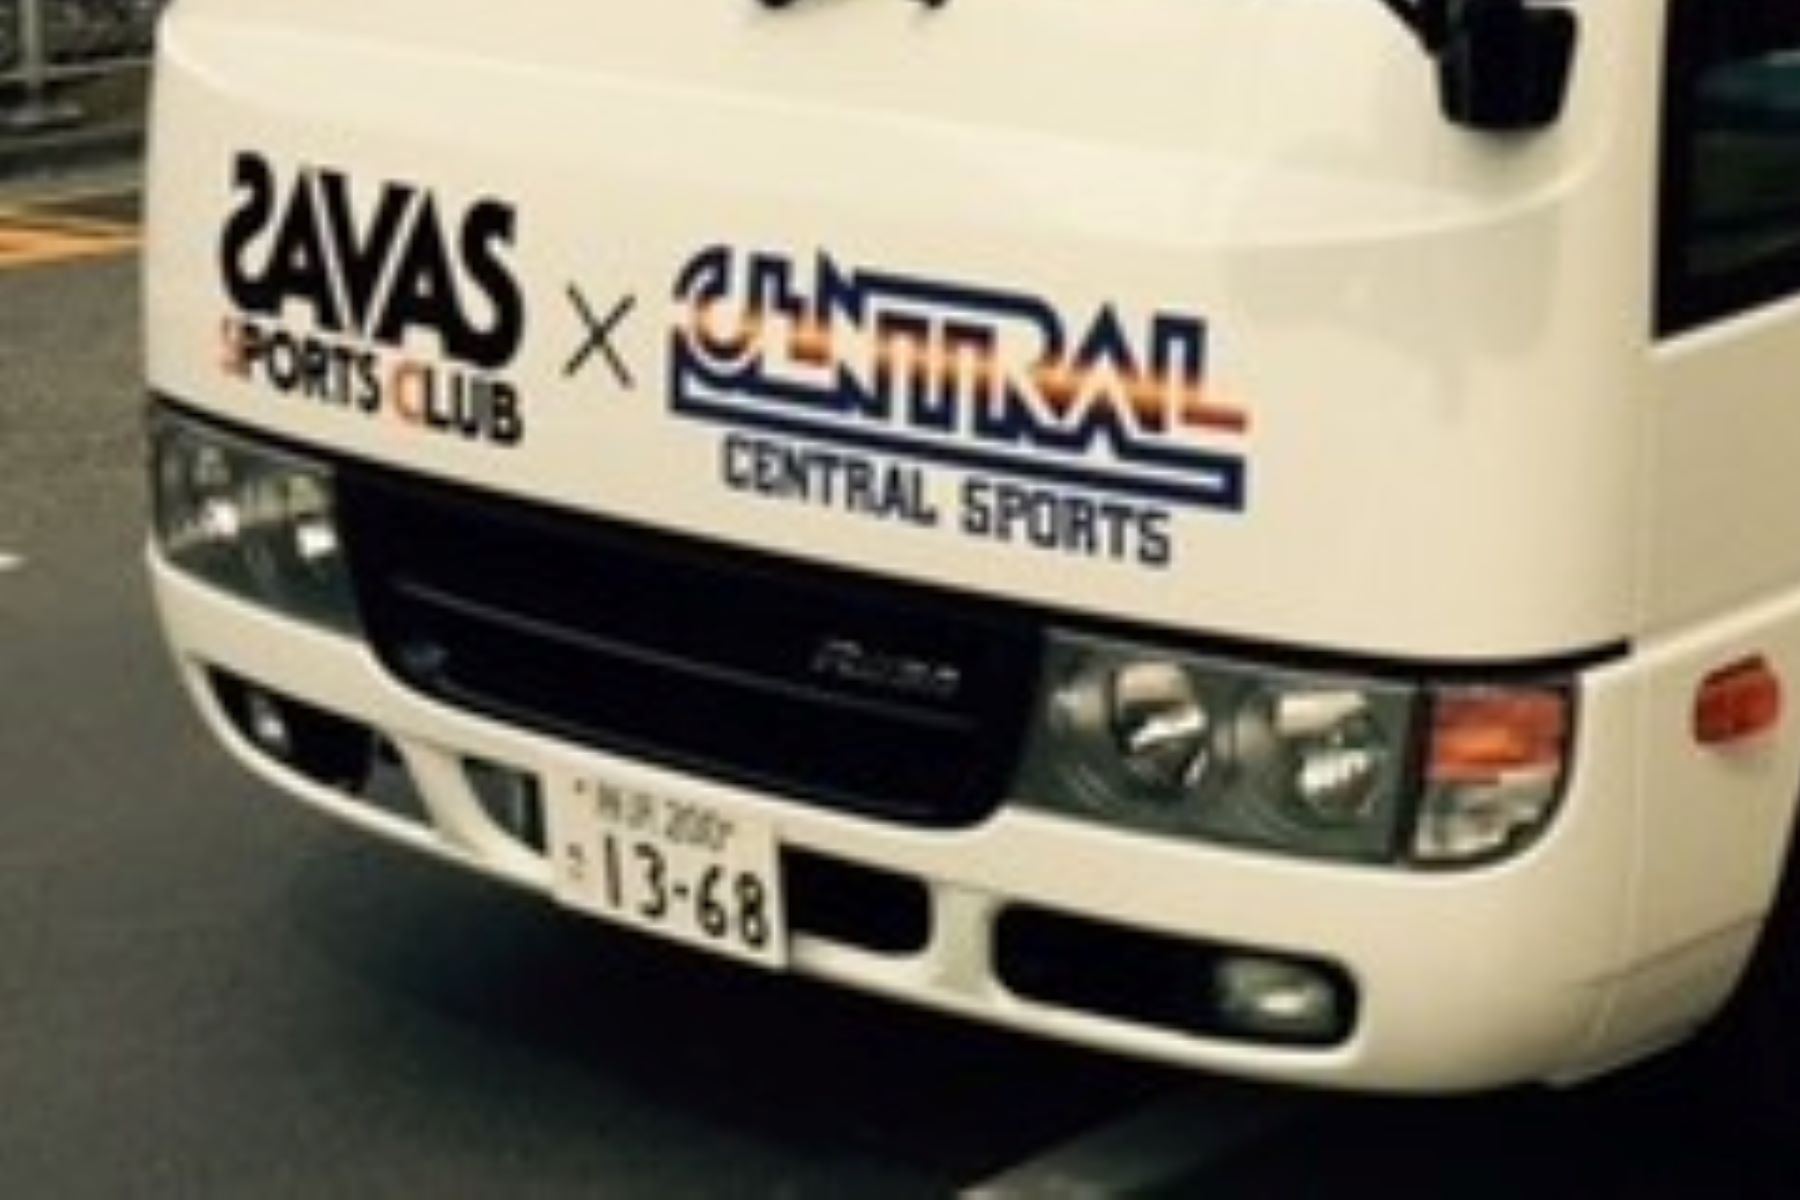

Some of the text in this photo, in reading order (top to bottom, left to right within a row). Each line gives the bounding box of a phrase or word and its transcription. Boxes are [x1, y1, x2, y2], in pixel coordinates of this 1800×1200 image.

[220, 149, 525, 368] SAVAS
[670, 245, 1247, 465] CENTRAL
[221, 315, 523, 445] SPORTS CLUB
[722, 433, 1172, 567] CENTRAL SPORTS
[605, 833, 770, 948] 13-68
